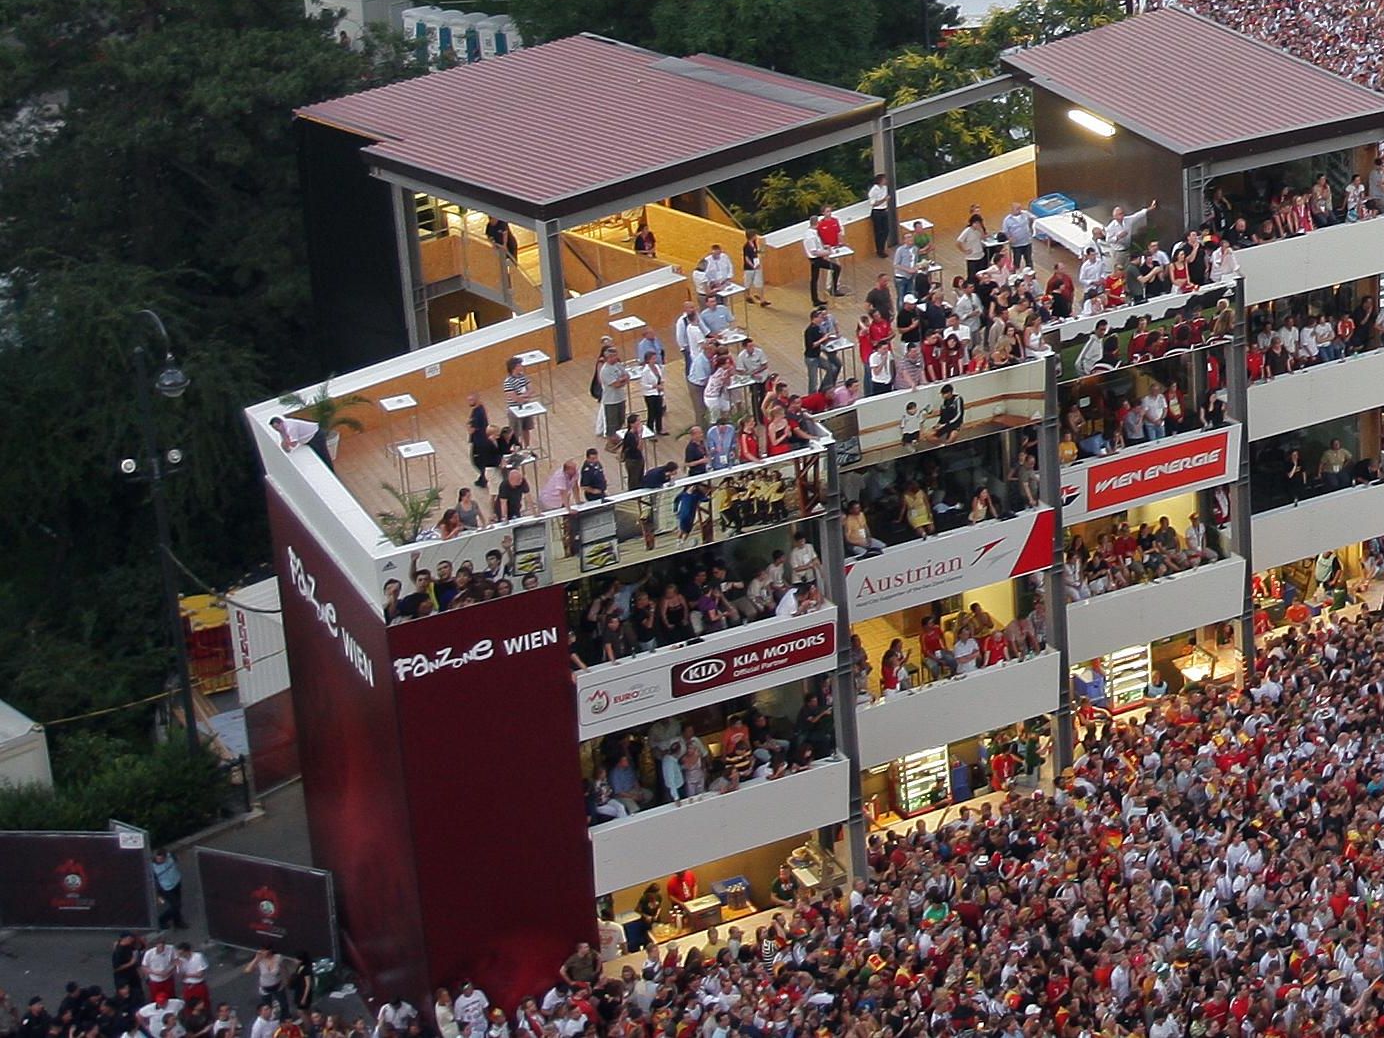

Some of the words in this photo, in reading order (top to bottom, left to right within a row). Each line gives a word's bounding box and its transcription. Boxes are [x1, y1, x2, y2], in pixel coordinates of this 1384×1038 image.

[1094, 470, 1143, 494] WIEN
[1144, 448, 1222, 481] ENERGIE
[856, 556, 963, 599] Austrian
[341, 627, 374, 688] WIEN
[503, 627, 558, 656] WIEN
[733, 653, 760, 668] KIA
[763, 632, 826, 660] MOTORS
[689, 664, 719, 680] KIA
